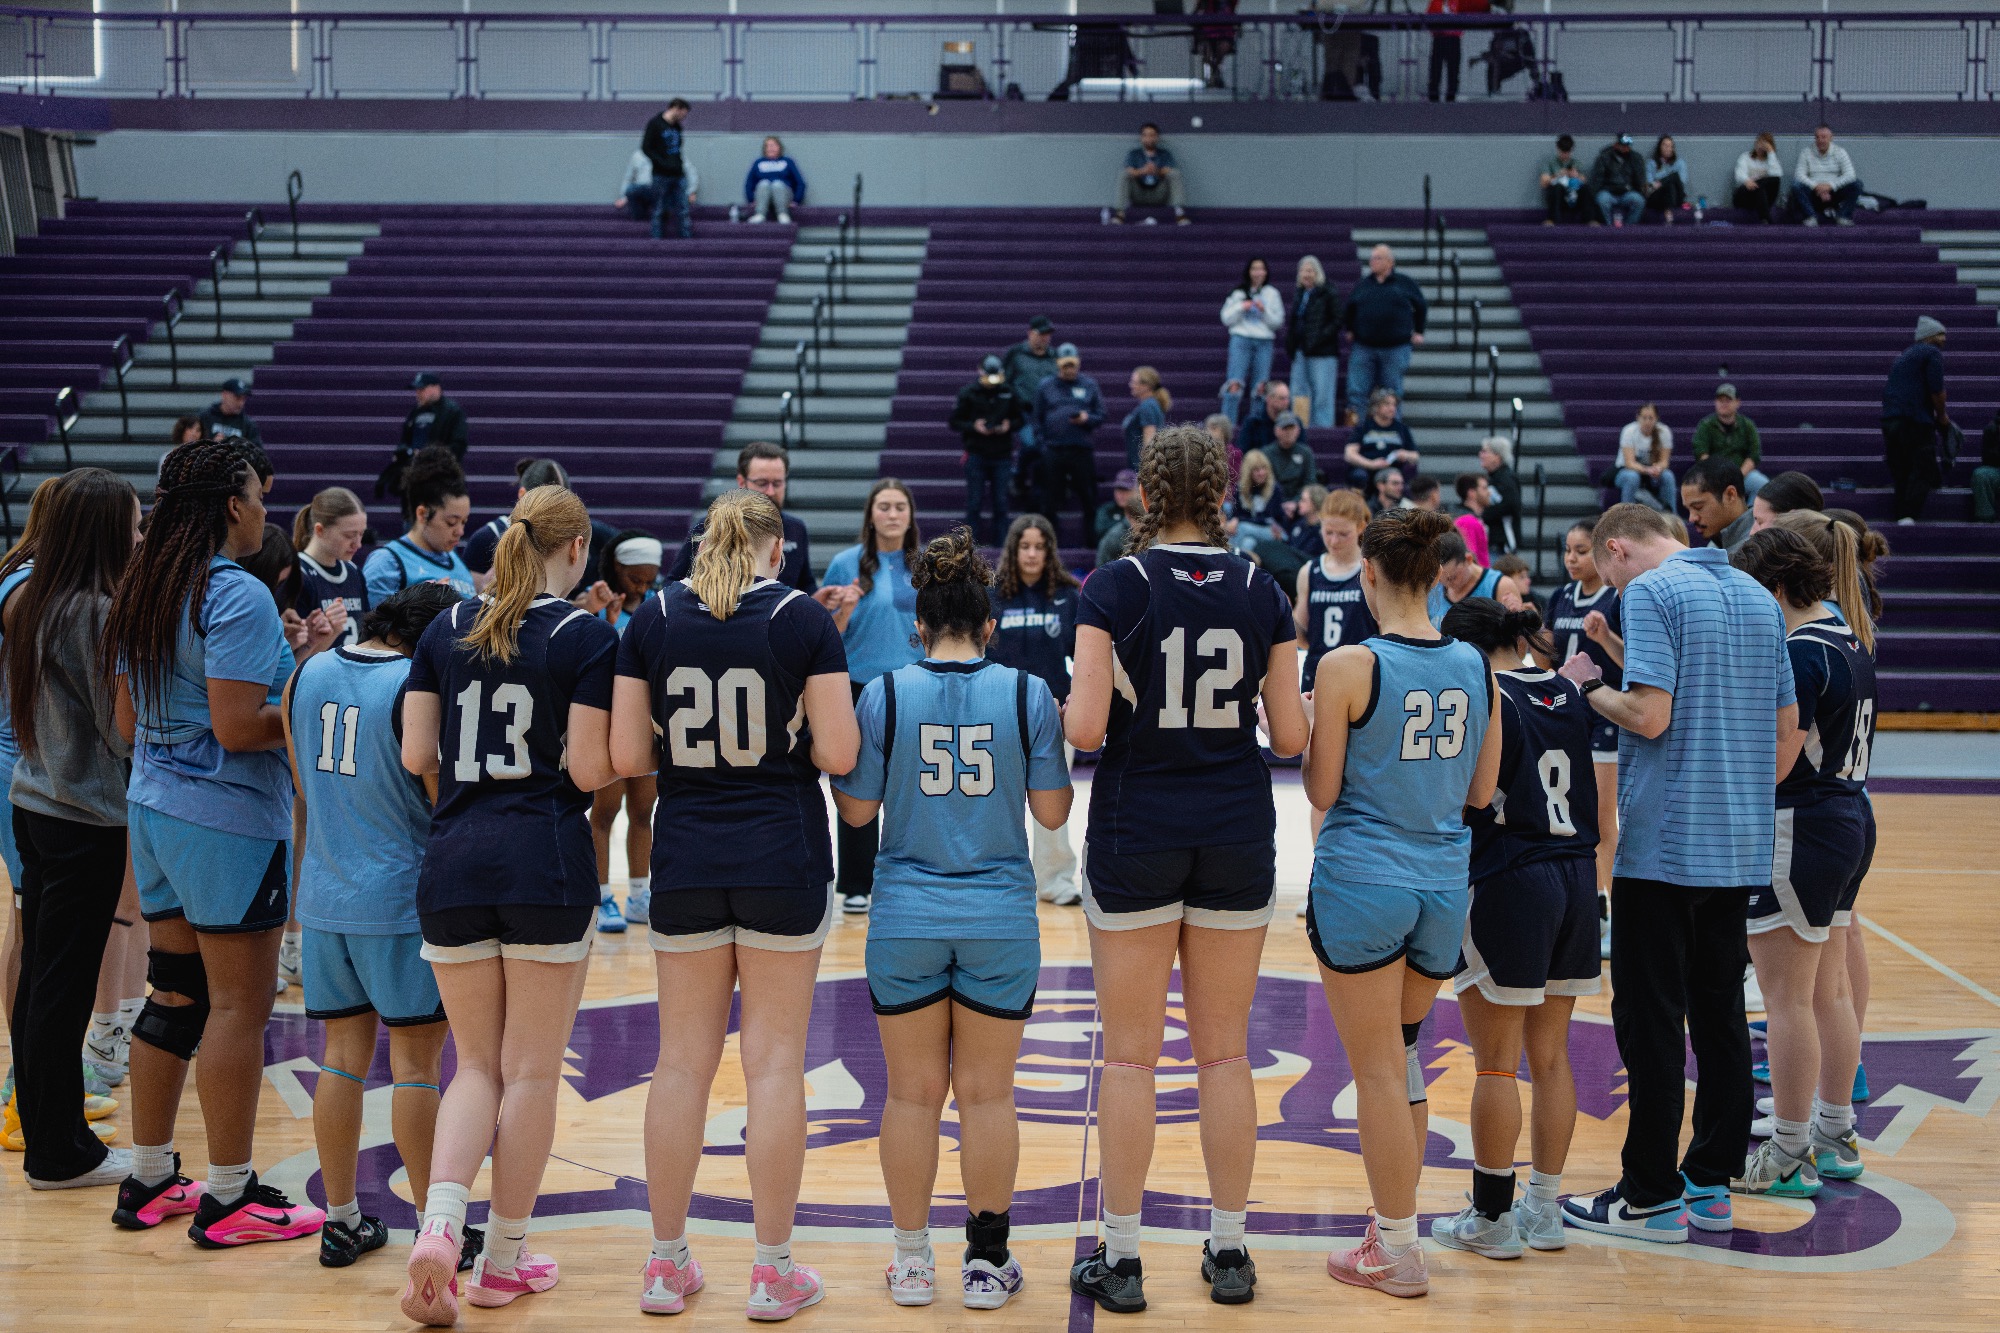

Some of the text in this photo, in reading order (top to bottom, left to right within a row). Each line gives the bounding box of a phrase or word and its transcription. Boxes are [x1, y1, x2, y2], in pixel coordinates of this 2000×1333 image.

[1310, 590, 1361, 603] PROVIDENCE
[1324, 606, 1343, 648] 6
[667, 667, 766, 767] 20
[1159, 627, 1244, 728] 12
[316, 701, 360, 777] 11
[455, 680, 533, 782] 13
[919, 723, 995, 796] 55
[1400, 688, 1469, 761] 23
[1836, 698, 1873, 781] 18
[1537, 749, 1577, 836] 8
